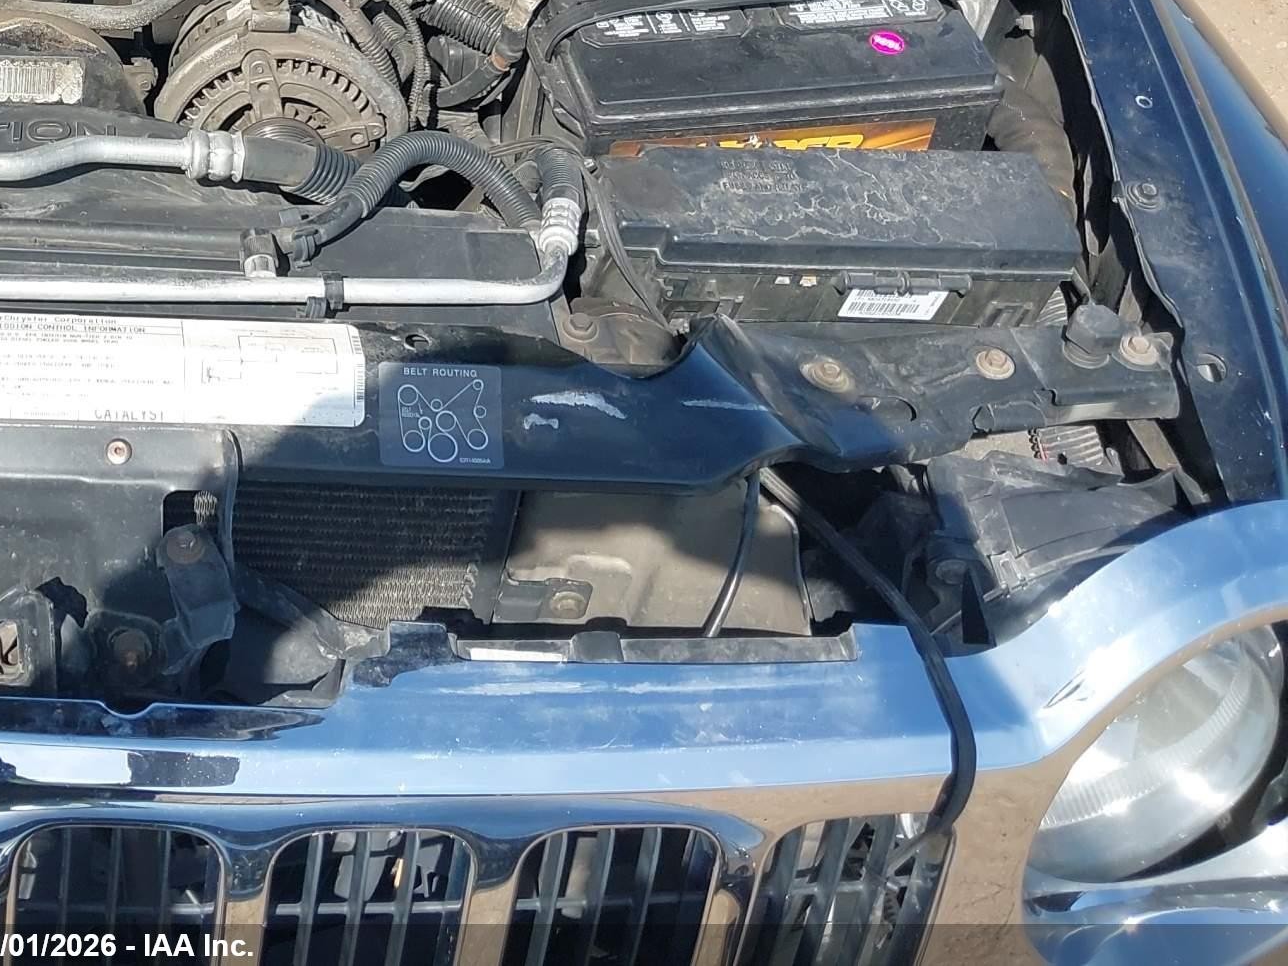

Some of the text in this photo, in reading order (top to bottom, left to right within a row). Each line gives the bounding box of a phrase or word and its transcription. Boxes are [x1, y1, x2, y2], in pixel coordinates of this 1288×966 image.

[54, 316, 117, 325] Corporation
[84, 325, 146, 334] INFORMATION
[403, 367, 478, 378] BELT ROUTING
[94, 409, 165, 422] CATALYST
